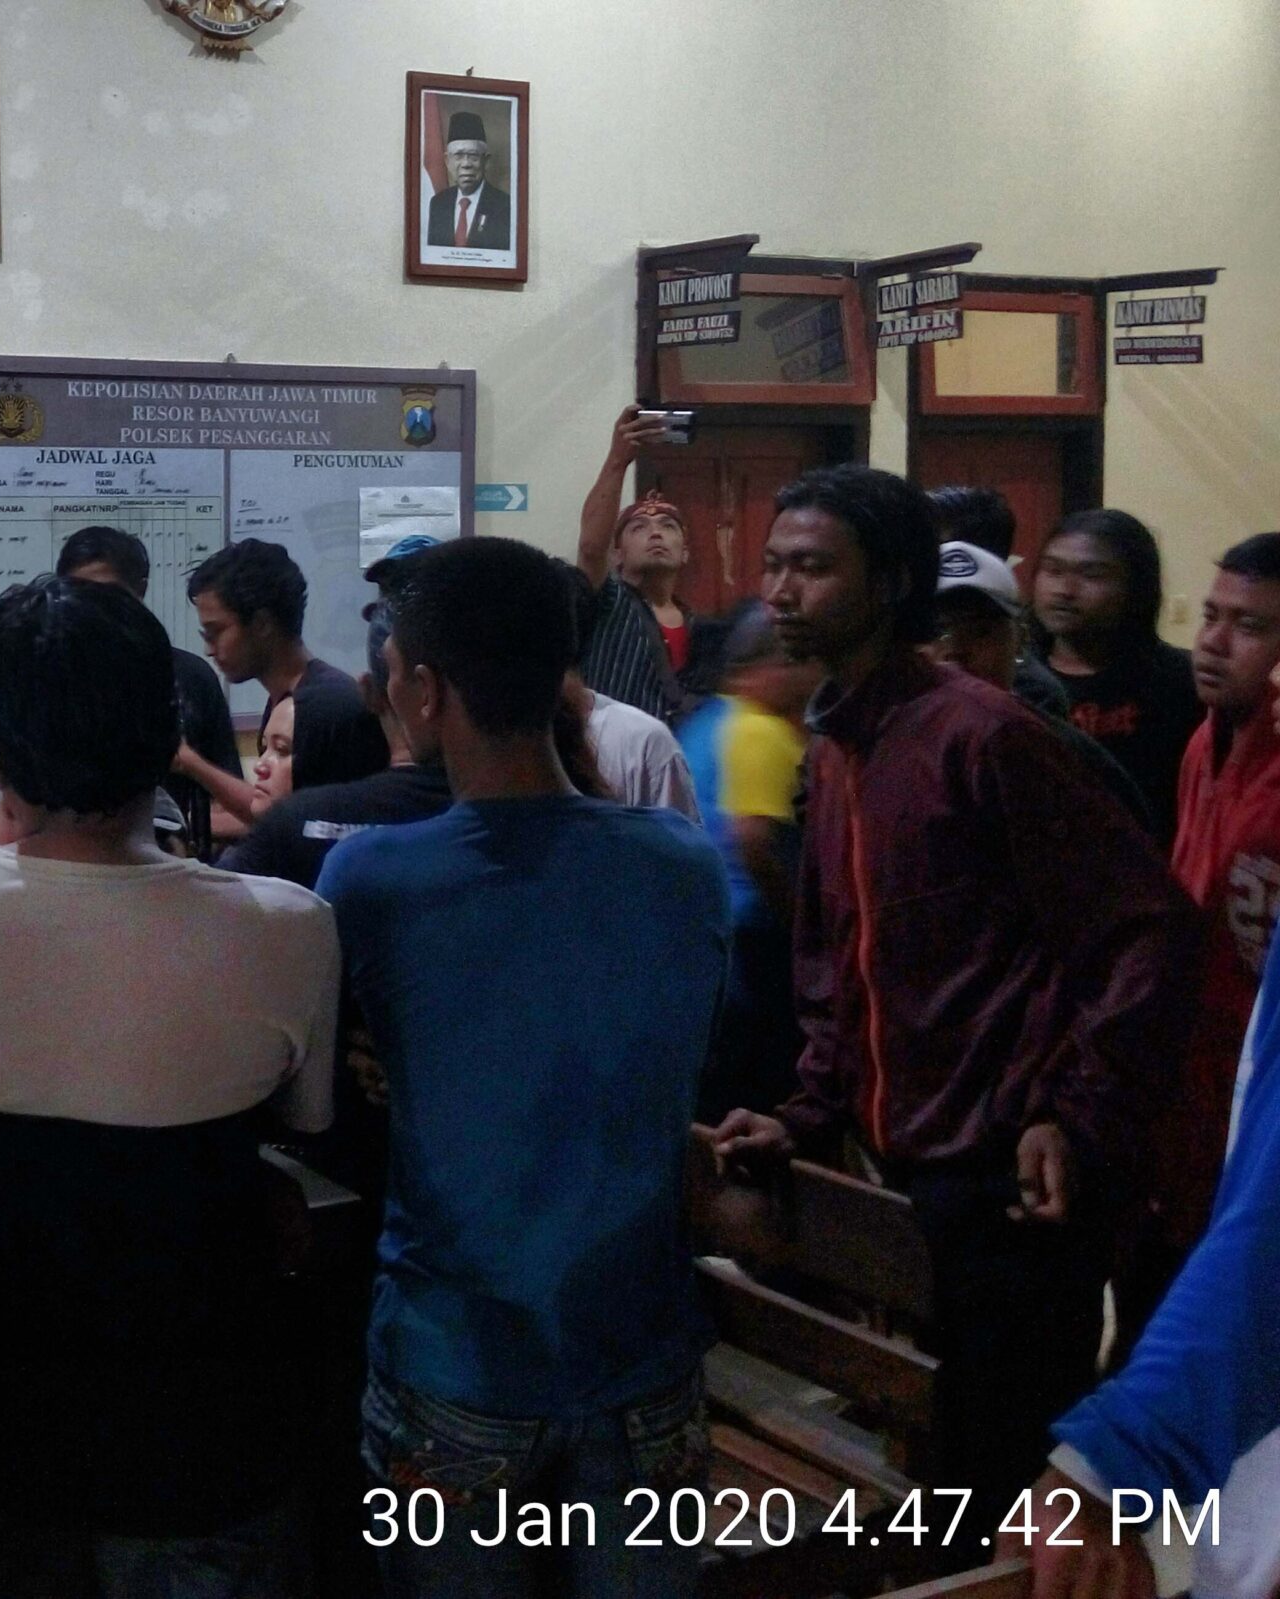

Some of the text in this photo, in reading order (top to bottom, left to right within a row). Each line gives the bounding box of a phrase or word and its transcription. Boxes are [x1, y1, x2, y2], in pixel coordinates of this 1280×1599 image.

[658, 273, 733, 306] KANIT PROVOST
[663, 314, 729, 333] FARIS FAUZI
[879, 311, 957, 335] ARIFIN
[66, 381, 378, 404] KEPOLISIAN DAERAH JAWA TIMUR
[131, 405, 321, 425] RESOR BANYUWANGI
[119, 427, 332, 446] POLSEK PESANGGARAN
[35, 450, 157, 465] JADWAL JAGA
[293, 454, 404, 468] PENGUMUMAN
[95, 470, 116, 478] REGU
[95, 479, 113, 487] HARI
[196, 505, 214, 513] KET
